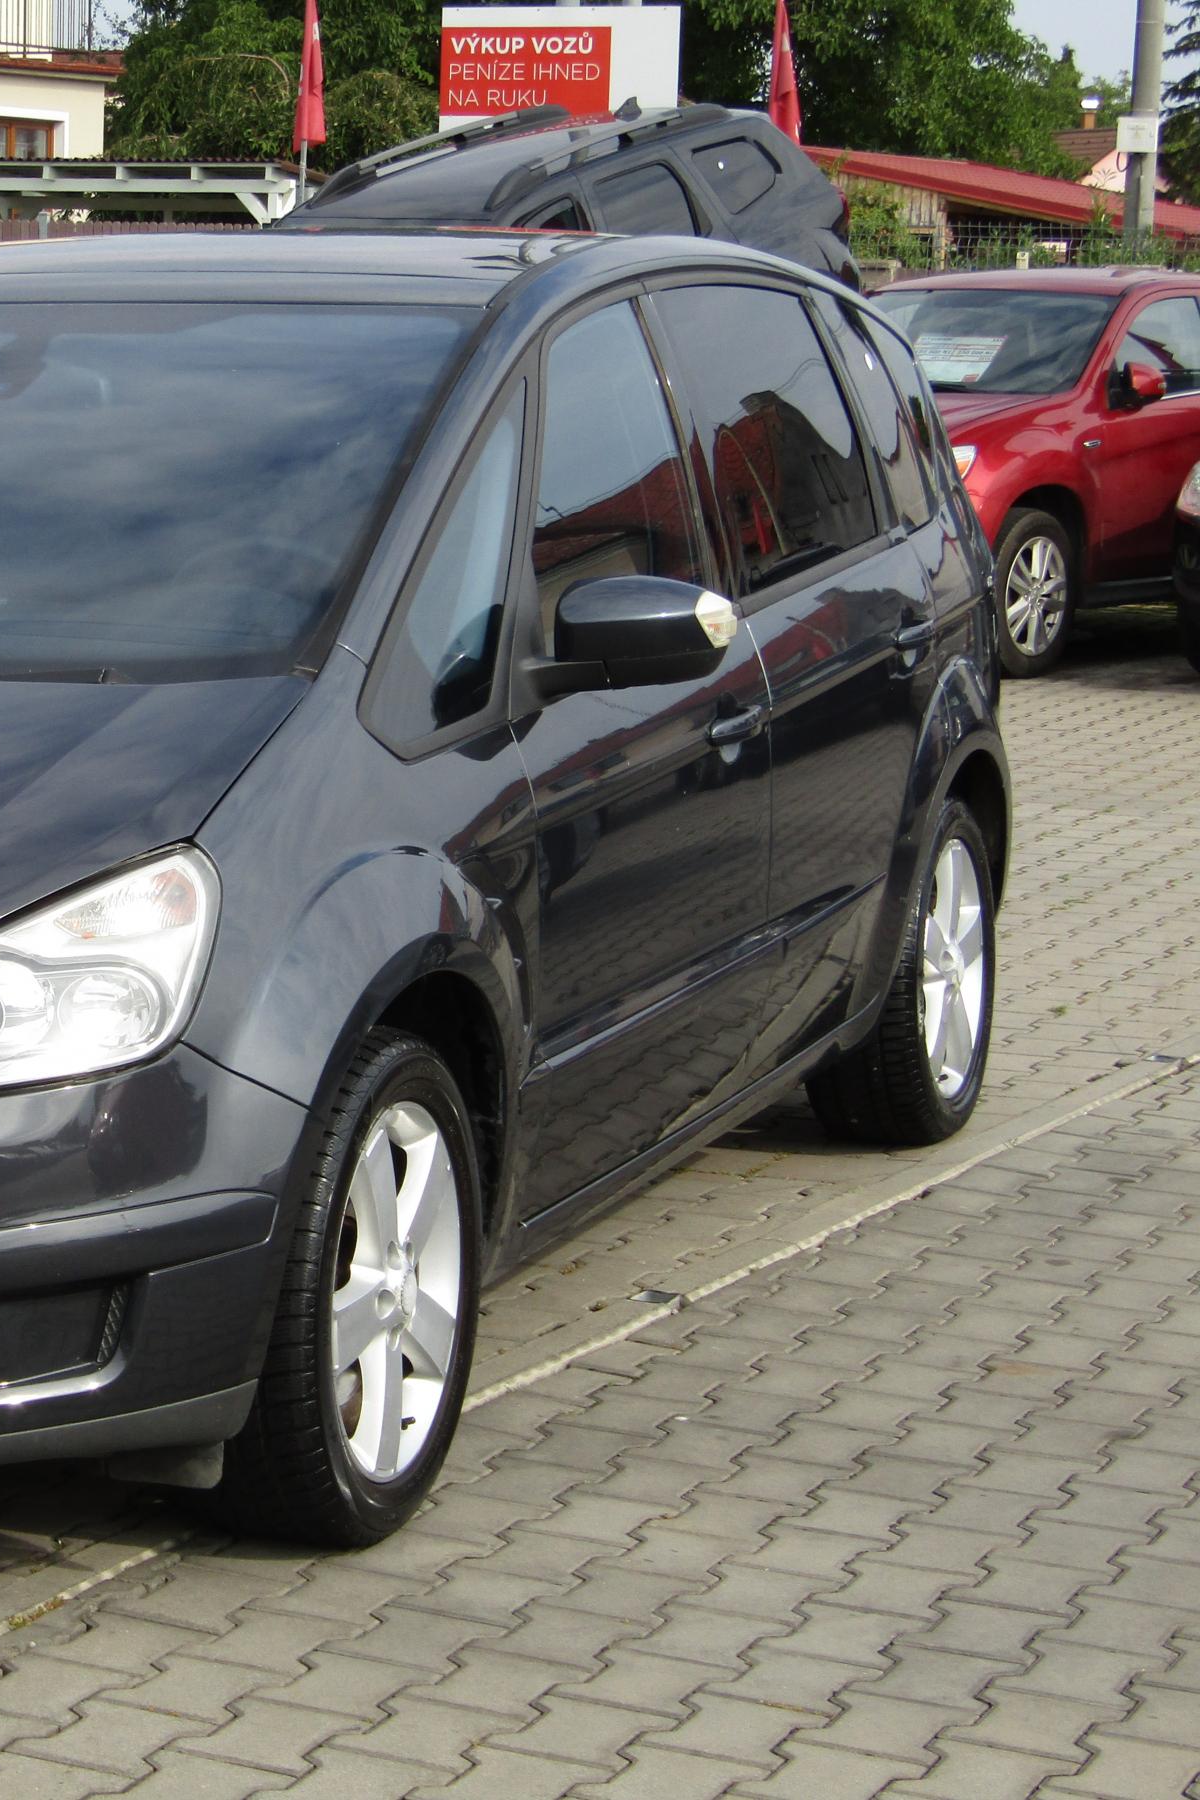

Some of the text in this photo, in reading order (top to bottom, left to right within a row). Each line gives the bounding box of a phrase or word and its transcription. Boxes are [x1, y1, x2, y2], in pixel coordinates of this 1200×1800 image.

[451, 32, 593, 54] VÝKUP VOZŮ
[449, 60, 600, 81] PENÍZE IHNED
[448, 89, 547, 107] NA RUKU
